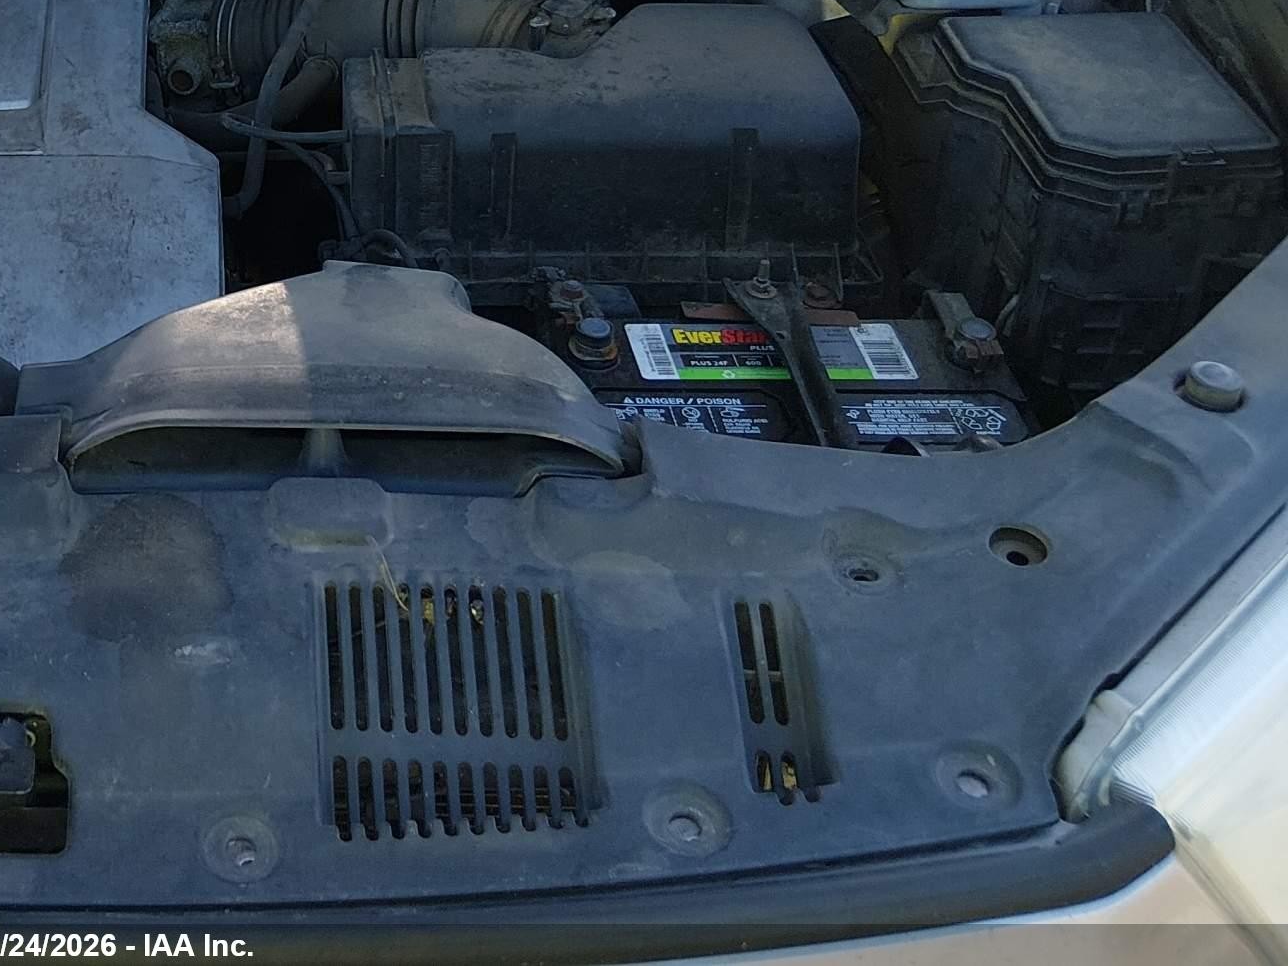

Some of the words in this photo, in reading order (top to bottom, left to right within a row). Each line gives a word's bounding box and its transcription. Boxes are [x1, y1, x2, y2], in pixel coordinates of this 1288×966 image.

[672, 328, 772, 345] EverStar
[636, 397, 685, 405] DANGER
[697, 397, 742, 405] POISON
